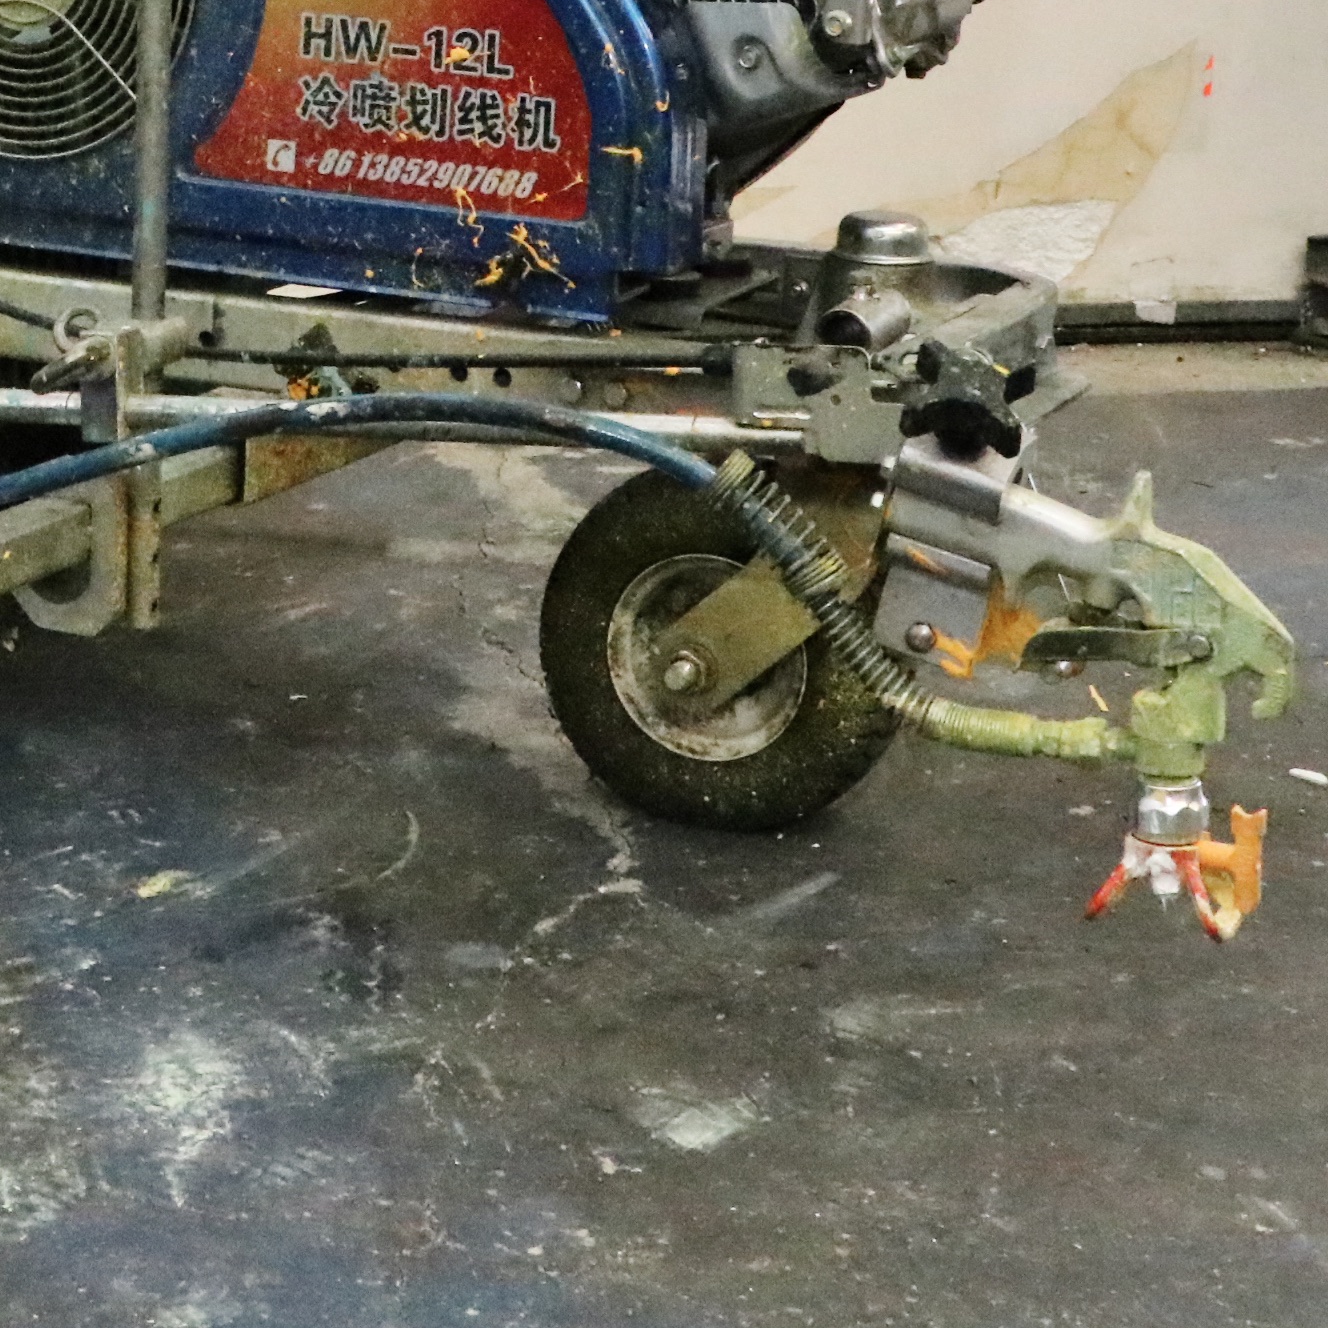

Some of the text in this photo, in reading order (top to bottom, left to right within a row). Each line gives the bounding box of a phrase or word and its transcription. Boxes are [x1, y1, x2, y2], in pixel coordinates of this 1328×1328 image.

[301, 13, 514, 78] HW-12L
[296, 73, 560, 152] 冷喷划线机
